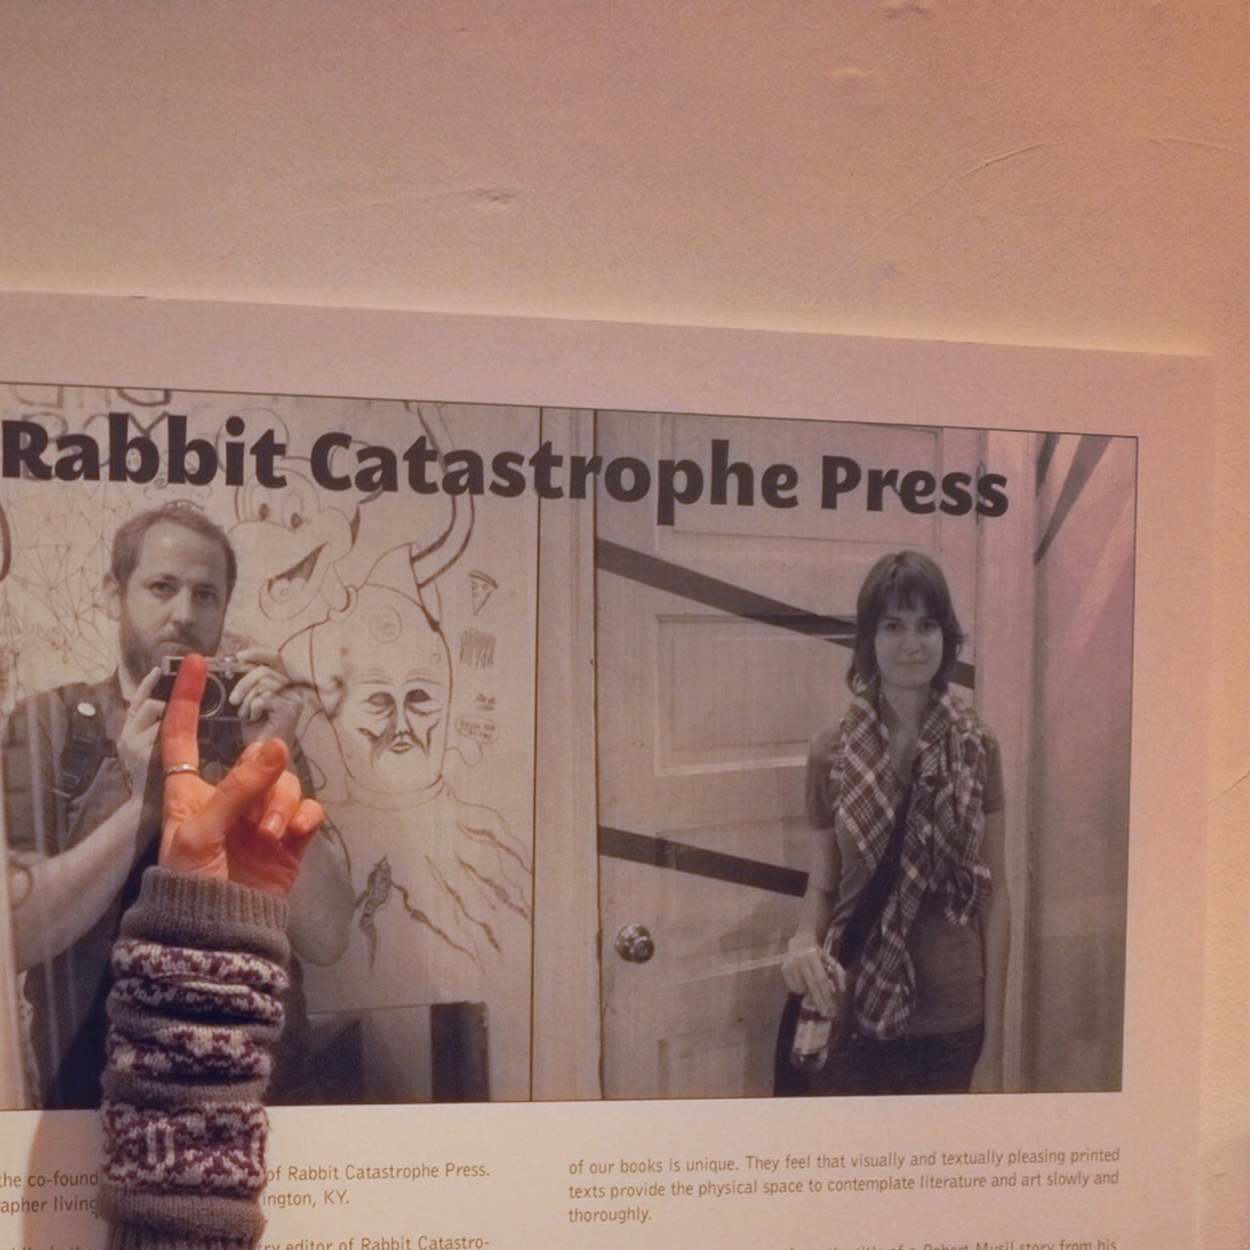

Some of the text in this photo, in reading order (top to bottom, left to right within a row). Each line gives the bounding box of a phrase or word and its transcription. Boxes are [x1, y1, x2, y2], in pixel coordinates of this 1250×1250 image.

[1, 412, 288, 488] Rabbit
[310, 432, 799, 526] Catastrophe
[821, 455, 1009, 517] Press
[287, 1164, 339, 1181] Rabbit
[344, 1162, 439, 1181] Catastrophe
[445, 1162, 490, 1177] Press.
[619, 1146, 1120, 1174] books unique. They feel that visually textually pleasing printed
[568, 1170, 1089, 1200] texts provide physical space contemplate literature slowly
[568, 1205, 651, 1224] thoroughly.
[417, 1235, 489, 1250] Catastro-
